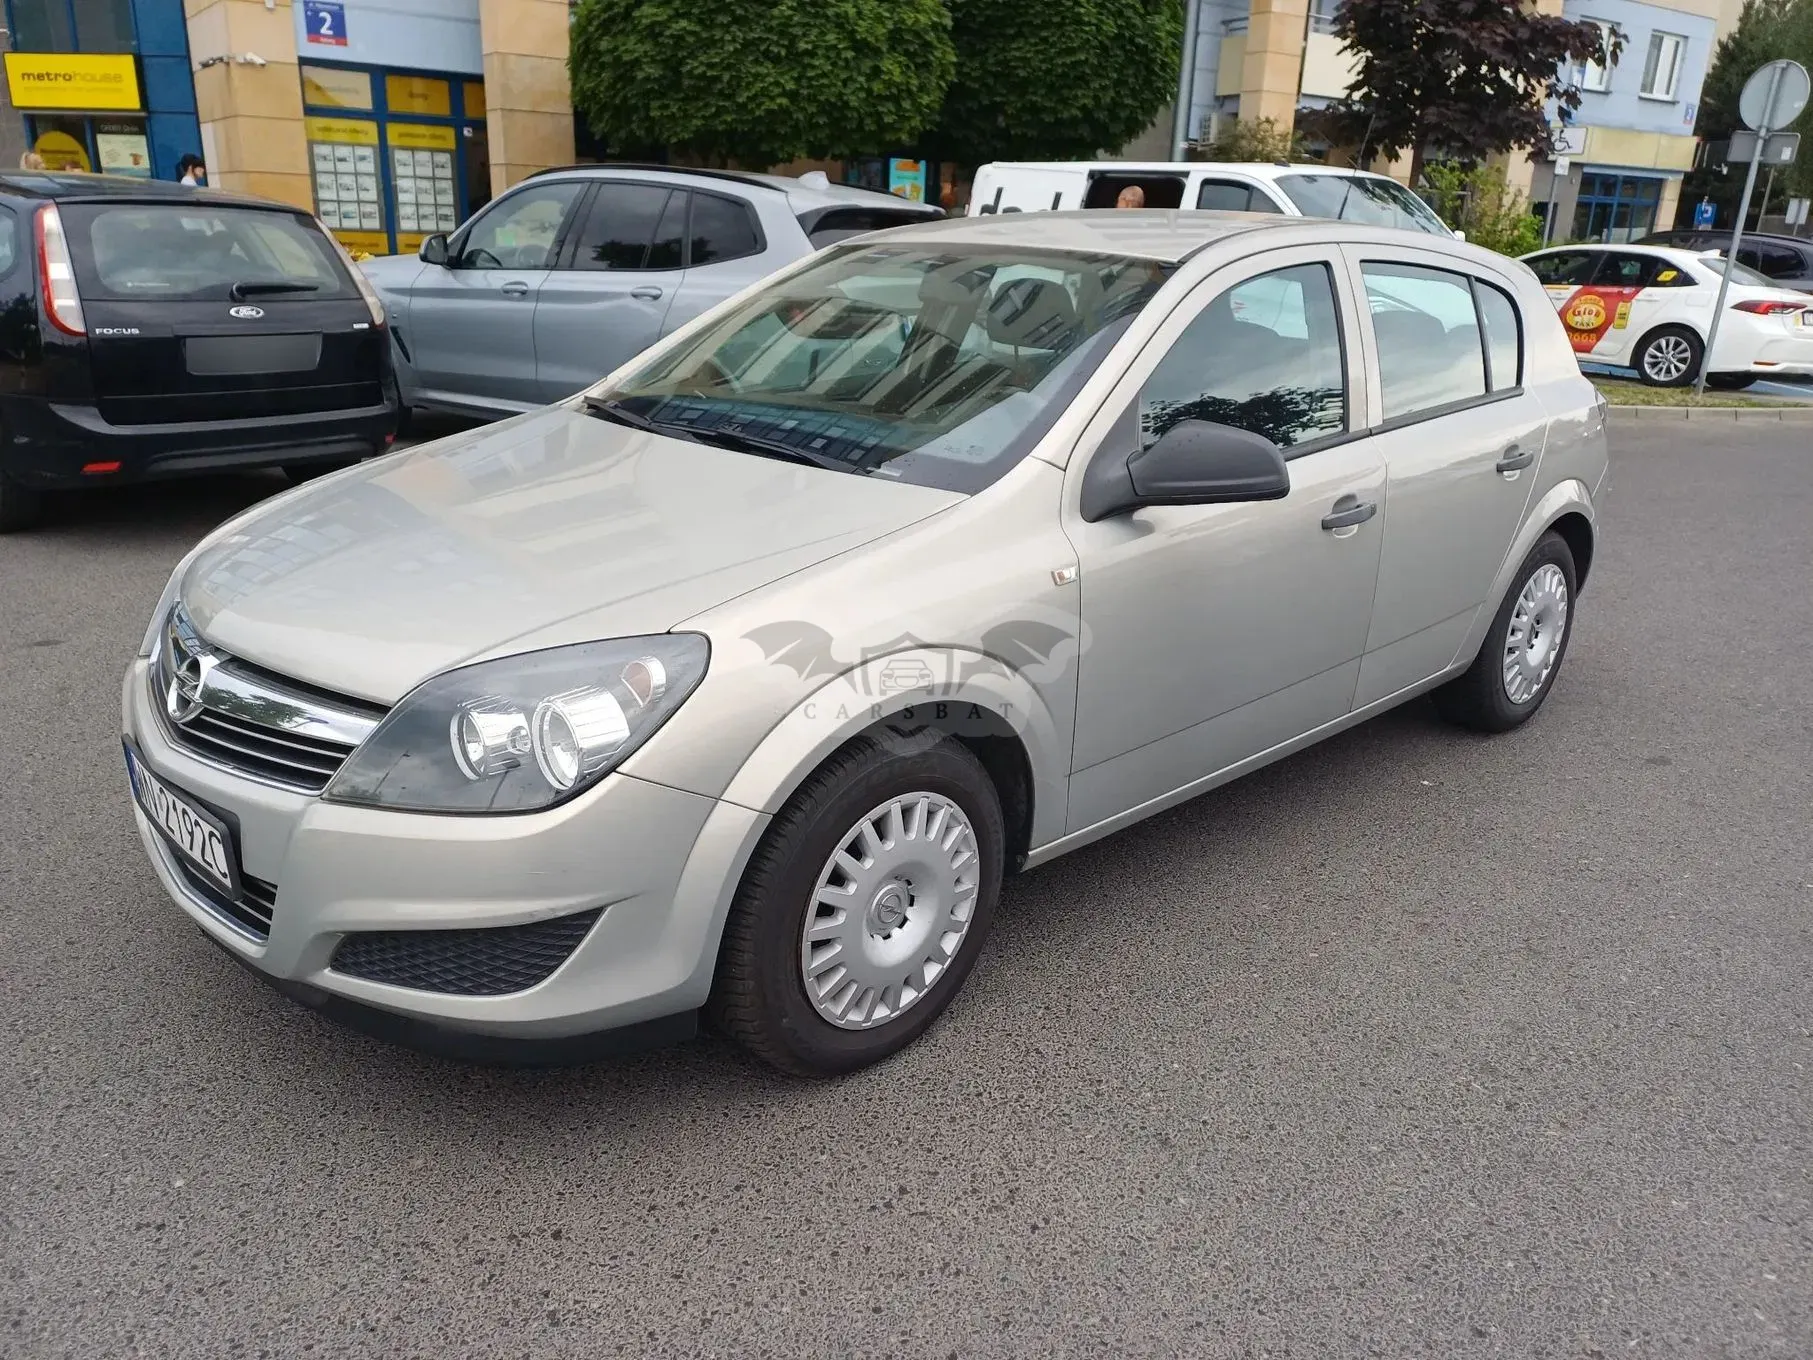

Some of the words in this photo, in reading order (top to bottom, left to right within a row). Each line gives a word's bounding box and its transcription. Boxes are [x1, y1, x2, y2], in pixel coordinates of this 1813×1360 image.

[319, 11, 334, 35] 2
[21, 70, 124, 83] metrohouse
[159, 786, 228, 879] 2192C
